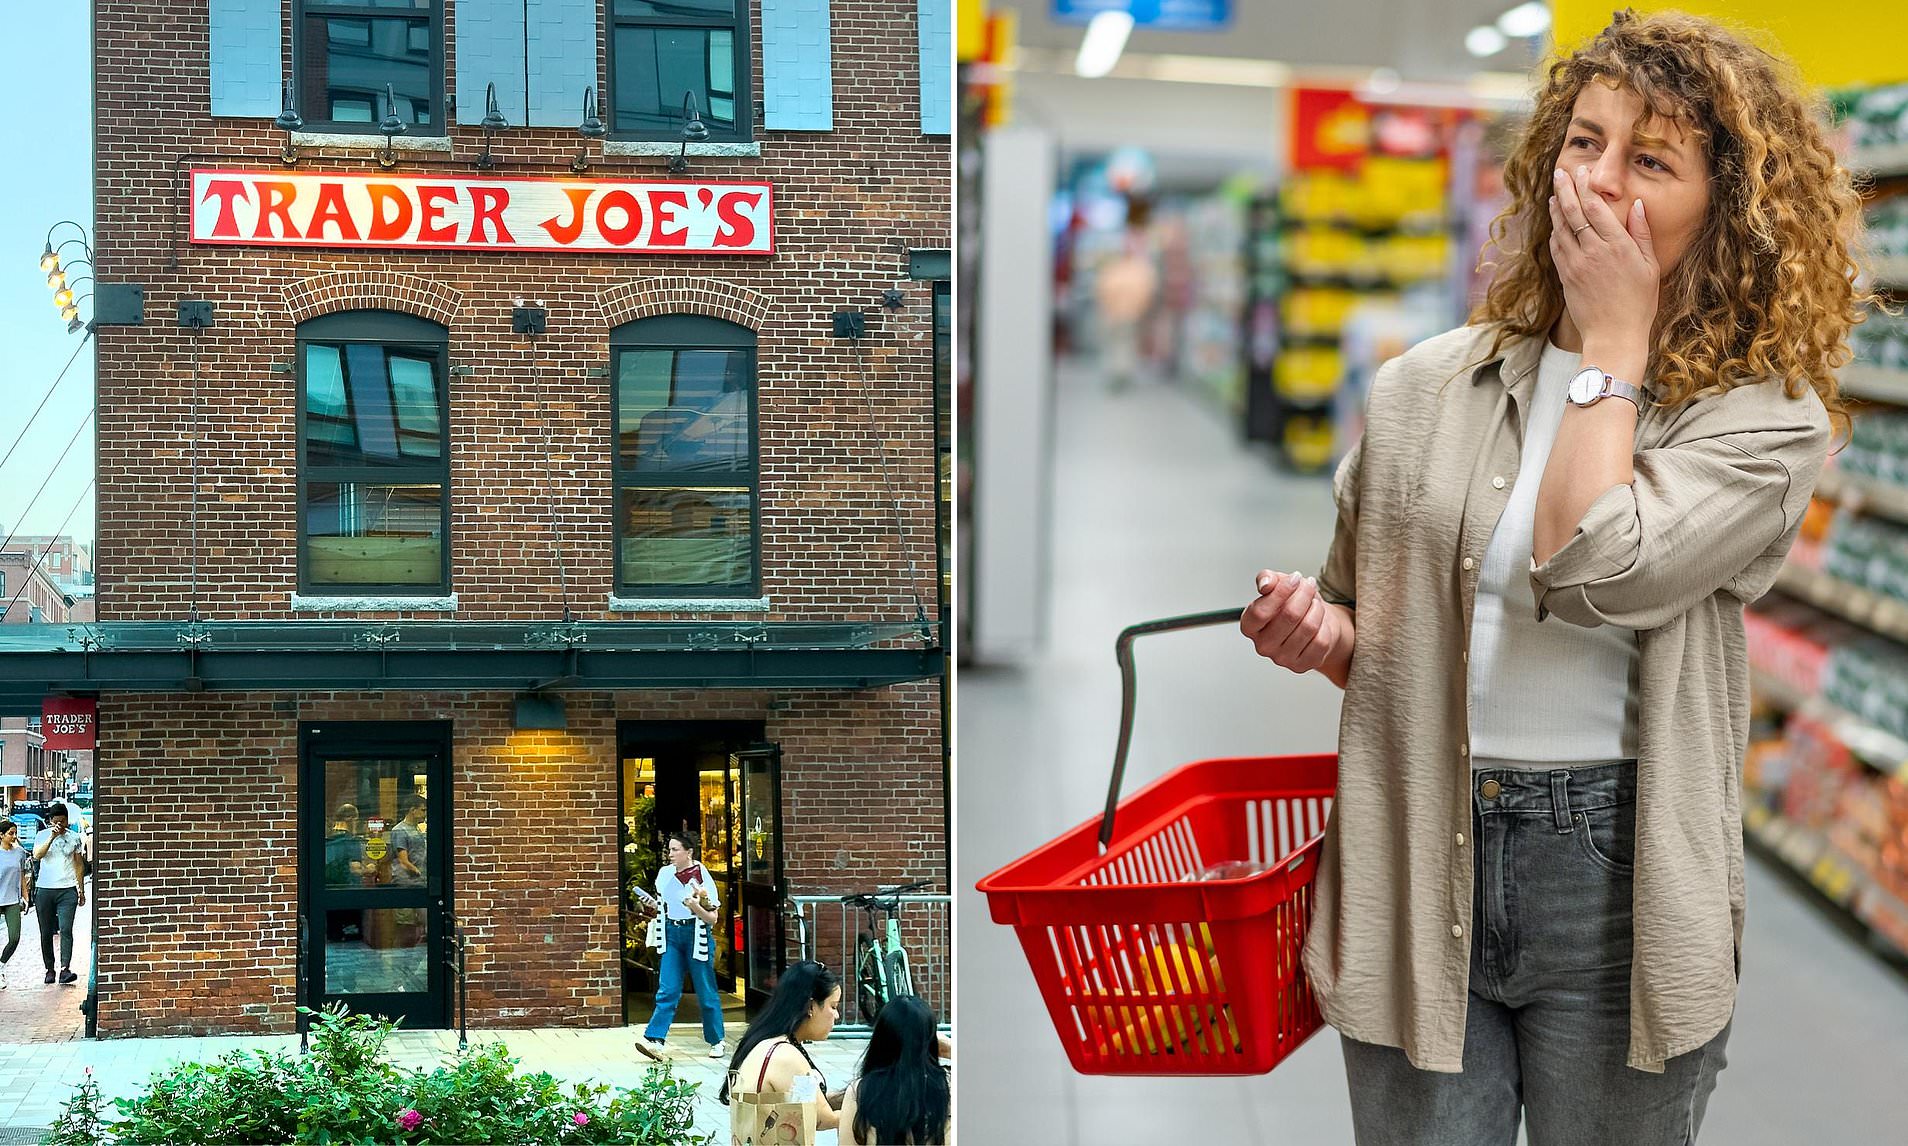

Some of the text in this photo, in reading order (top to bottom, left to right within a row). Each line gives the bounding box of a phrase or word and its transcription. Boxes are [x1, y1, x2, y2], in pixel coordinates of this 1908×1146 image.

[201, 180, 763, 248] TRADER JOE'S
[46, 714, 93, 724] TRADER
[52, 724, 86, 734] JOE'S
